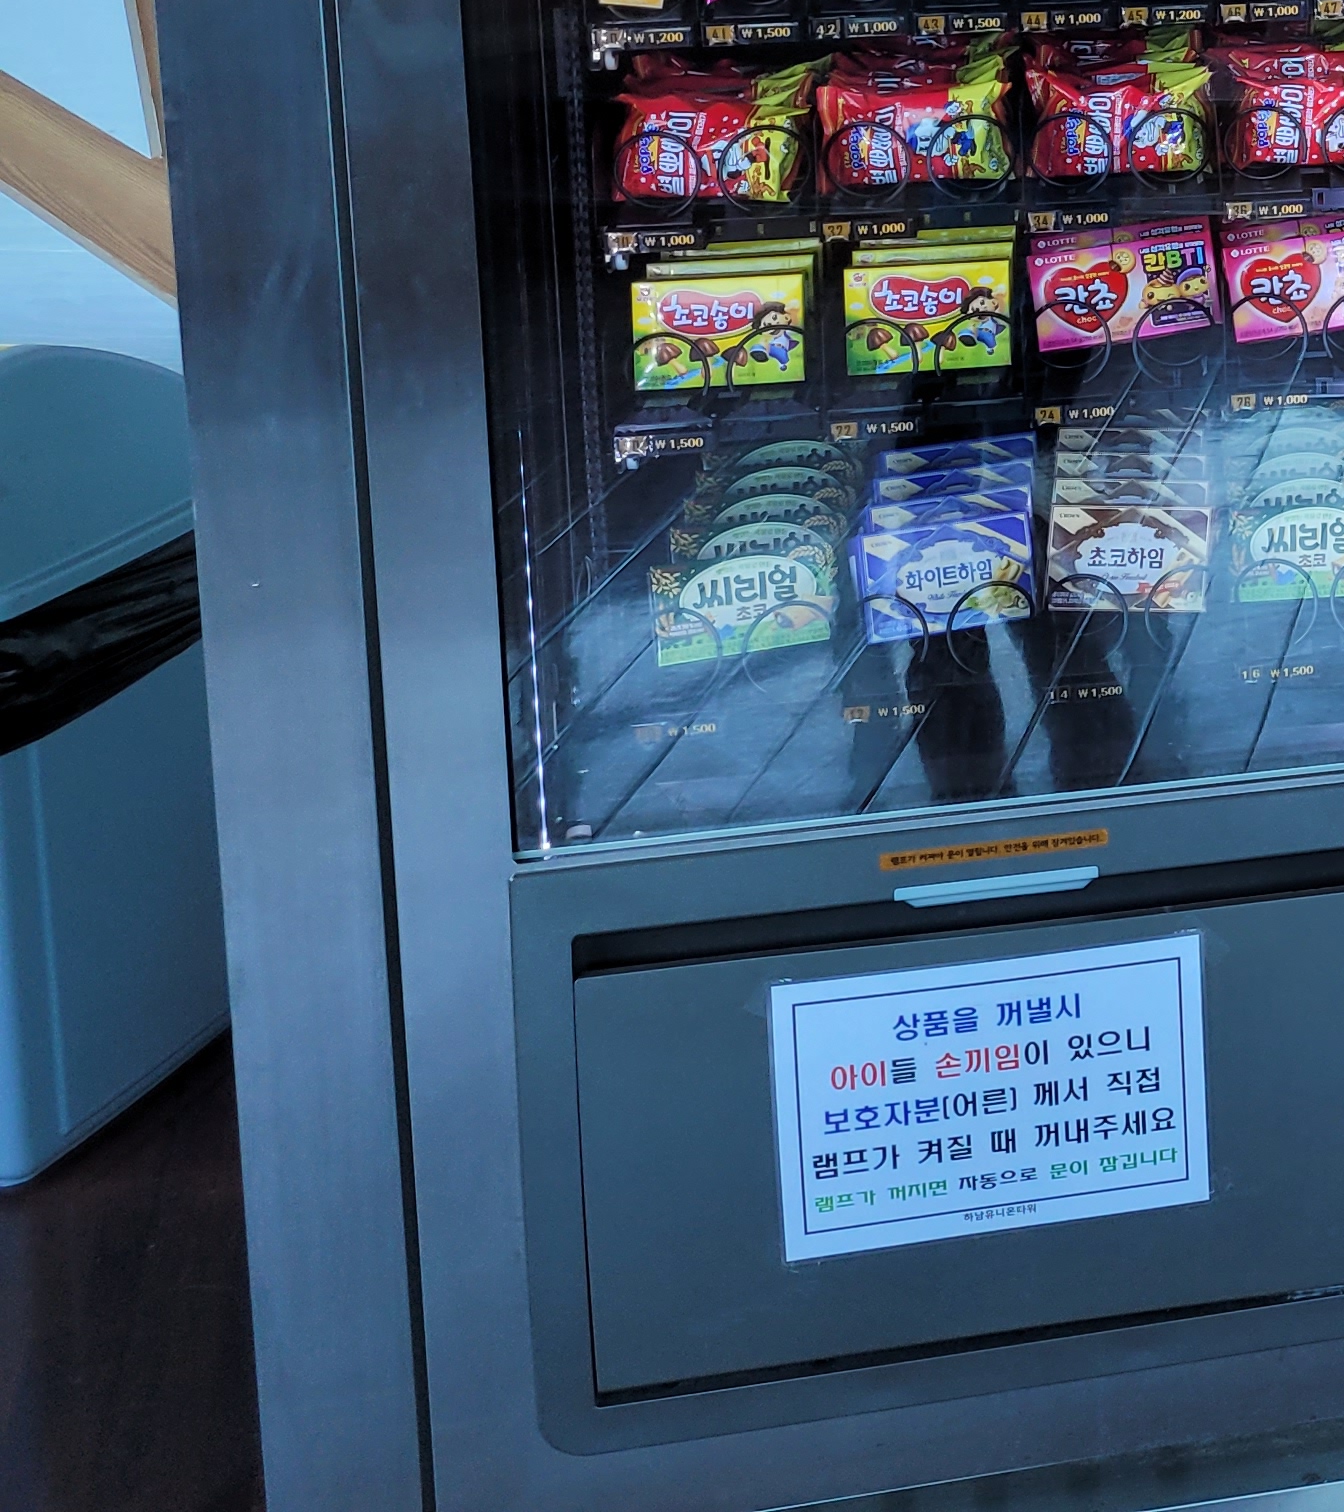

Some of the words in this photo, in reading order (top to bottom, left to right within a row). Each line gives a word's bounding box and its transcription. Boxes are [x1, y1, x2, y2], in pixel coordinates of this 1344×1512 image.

[1045, 254, 1076, 264] LOTTE
[662, 294, 754, 331] 초코송이
[874, 279, 963, 314] 초코송이
[693, 564, 798, 609] 씨리얼
[904, 558, 993, 591] 화이트하임
[892, 1005, 979, 1041] 상품을
[996, 993, 1083, 1028] 꺼낼시
[830, 1057, 918, 1091] 아이들
[935, 1039, 1049, 1080] 손끼임이
[1067, 1025, 1151, 1061] 있으니
[823, 1086, 1019, 1136] 보호자분(어른)
[1033, 1076, 1089, 1107] 께서
[1106, 1066, 1162, 1097] 직접
[812, 1144, 901, 1180] 램프가
[917, 1136, 974, 1165] 켜질
[990, 1128, 1017, 1154] 때
[1034, 1106, 1177, 1148] 꺼내주세요
[813, 1190, 877, 1213] 램프가
[886, 1178, 949, 1202] 꺼지면
[958, 1166, 1038, 1192] 자동으로
[1049, 1159, 1089, 1180] 문이
[1099, 1146, 1178, 1173] 잠깁니다
[963, 1203, 1038, 1223] 하남유니온타워
